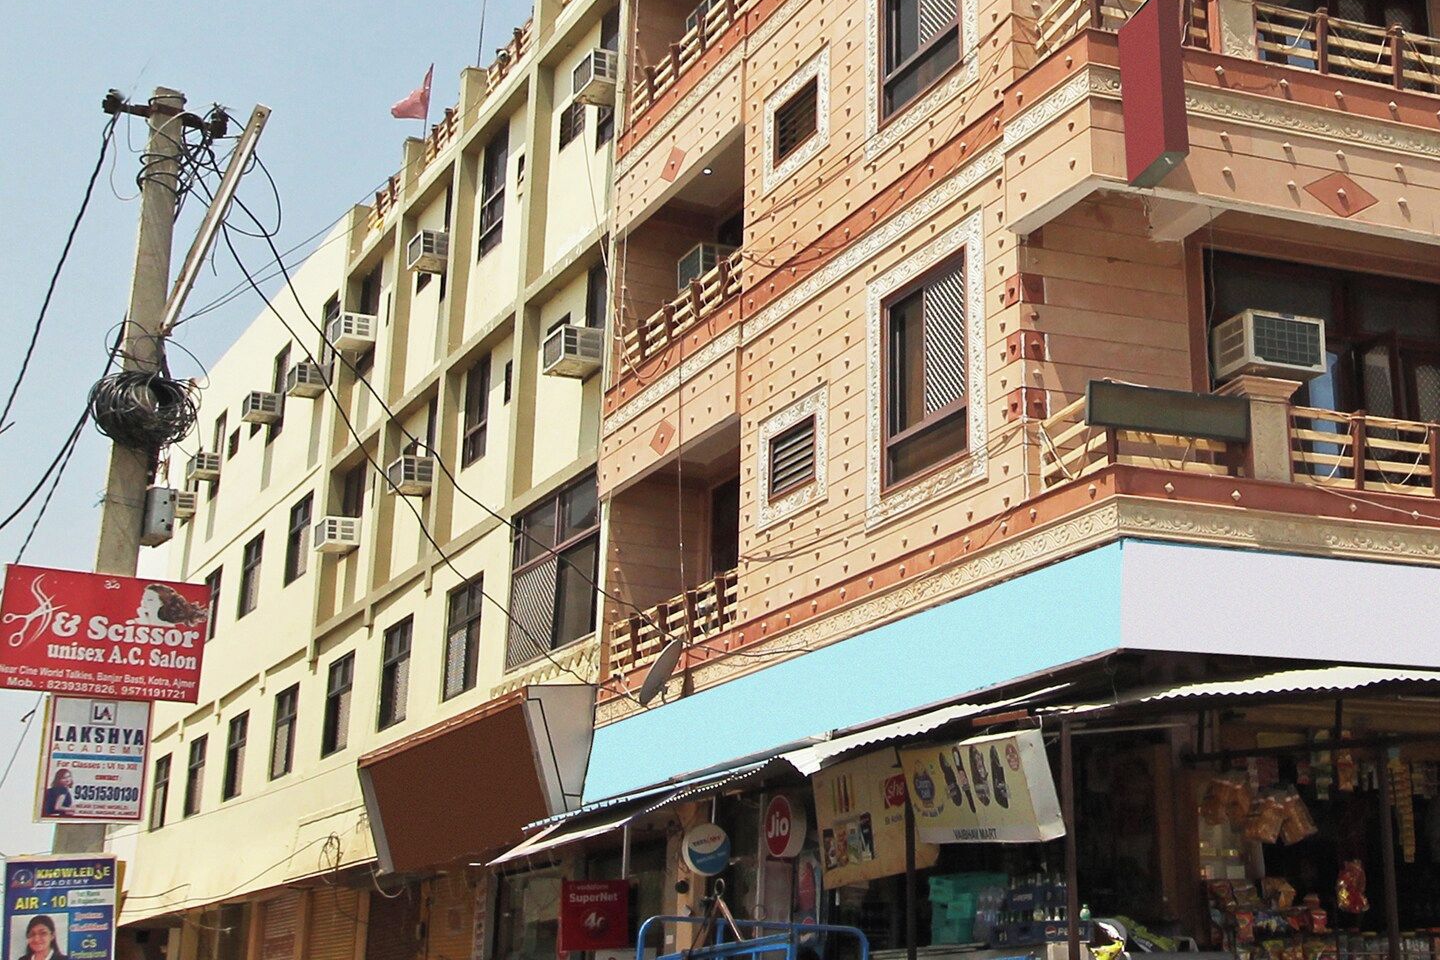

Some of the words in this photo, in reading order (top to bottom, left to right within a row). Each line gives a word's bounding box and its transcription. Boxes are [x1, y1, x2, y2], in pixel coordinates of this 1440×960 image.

[51, 611, 82, 638] &
[86, 615, 200, 648] Scissor
[47, 641, 105, 663] unisex
[108, 644, 145, 666] A.C.
[149, 649, 197, 671] Salon
[39, 667, 64, 678] World
[54, 725, 145, 746] LAKSHYA
[53, 743, 144, 755] ACADEMY
[74, 784, 139, 802] 9351530130
[767, 810, 790, 839] Jio
[35, 878, 90, 887] ACADEMY
[15, 896, 39, 910] AIR
[51, 895, 67, 908] 10
[569, 892, 618, 906] SuperNet
